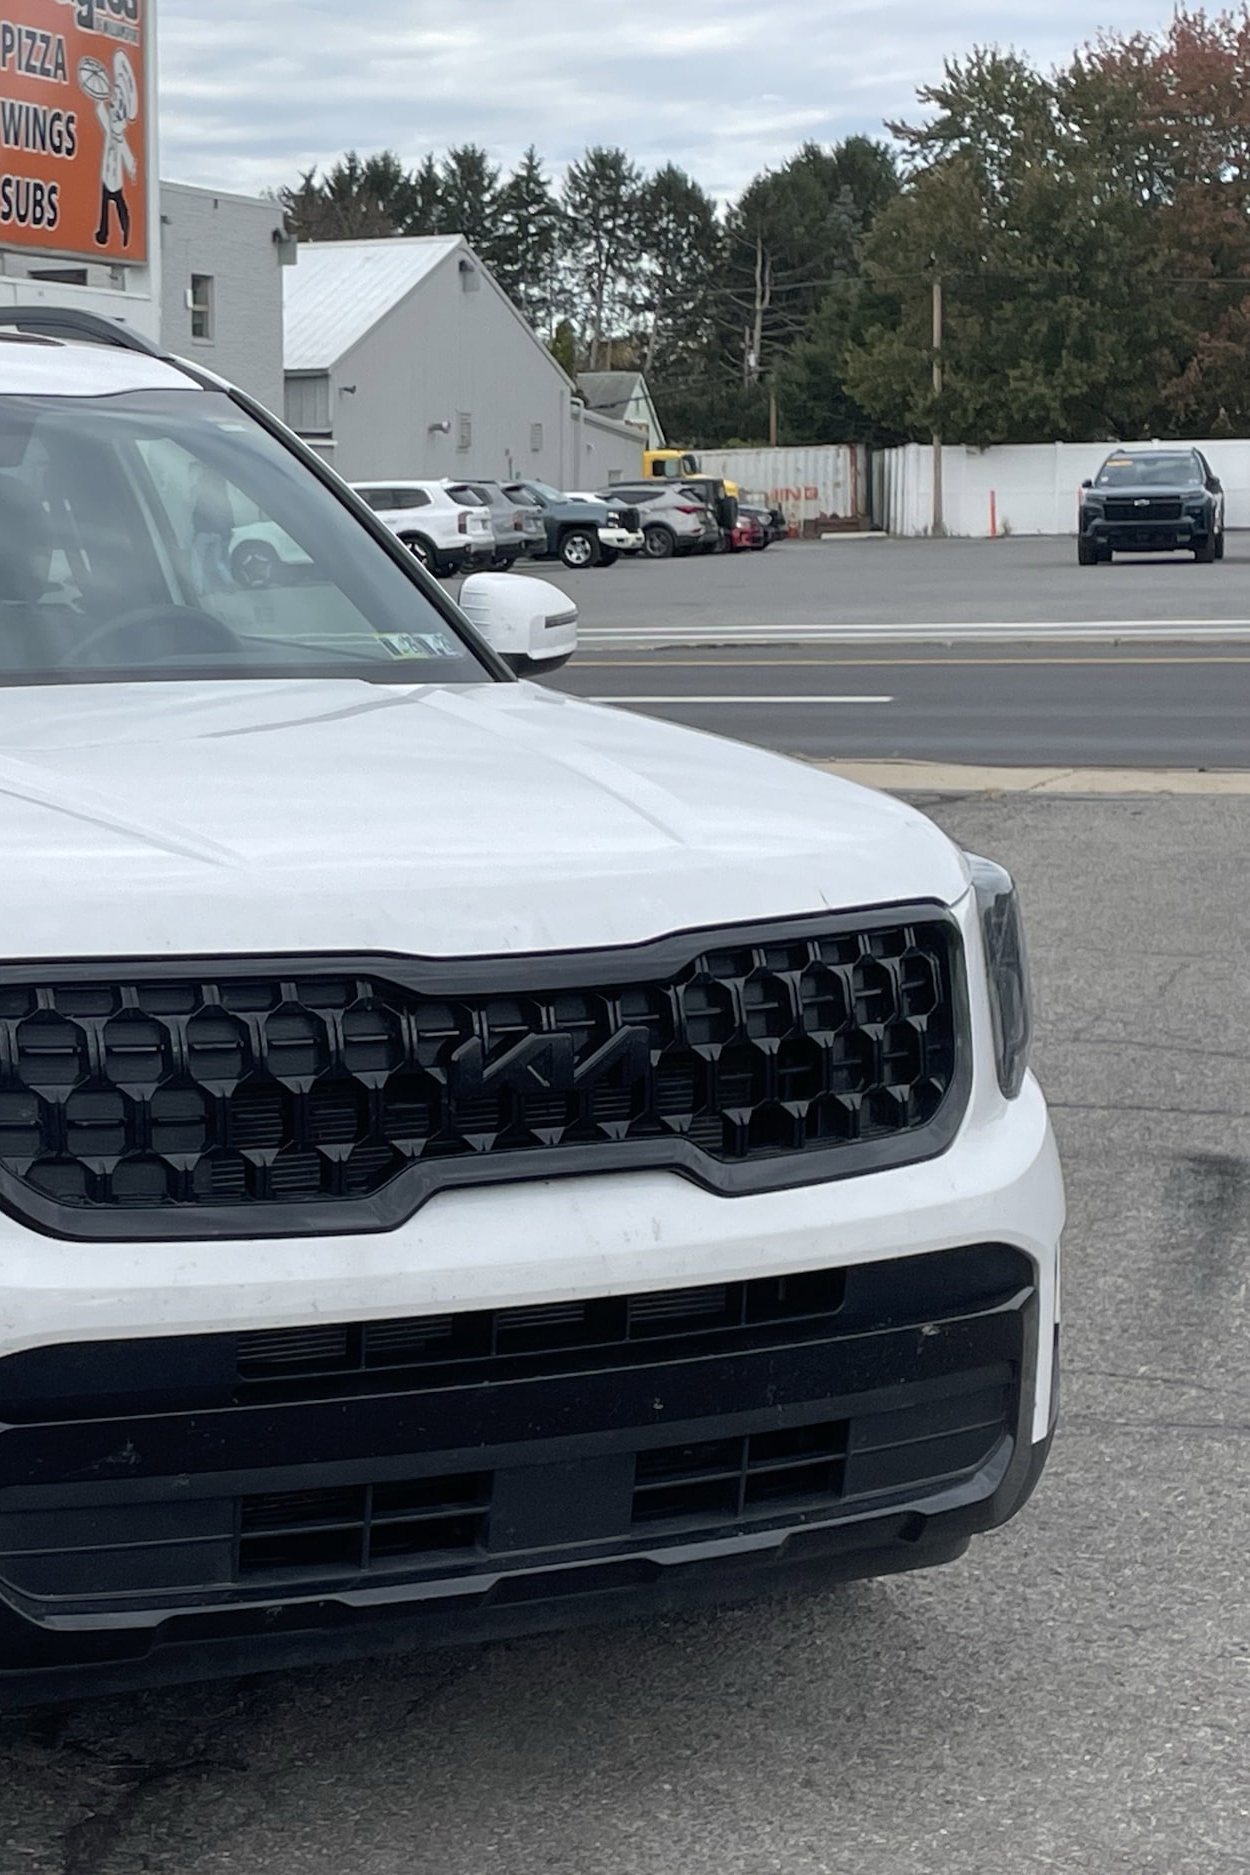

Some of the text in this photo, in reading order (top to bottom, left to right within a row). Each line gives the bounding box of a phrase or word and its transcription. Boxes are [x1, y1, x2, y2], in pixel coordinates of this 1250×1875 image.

[0, 22, 68, 83] PIZZA
[0, 99, 76, 158] WINGS
[0, 175, 59, 228] SUBS
[451, 1025, 650, 1090] KIA
